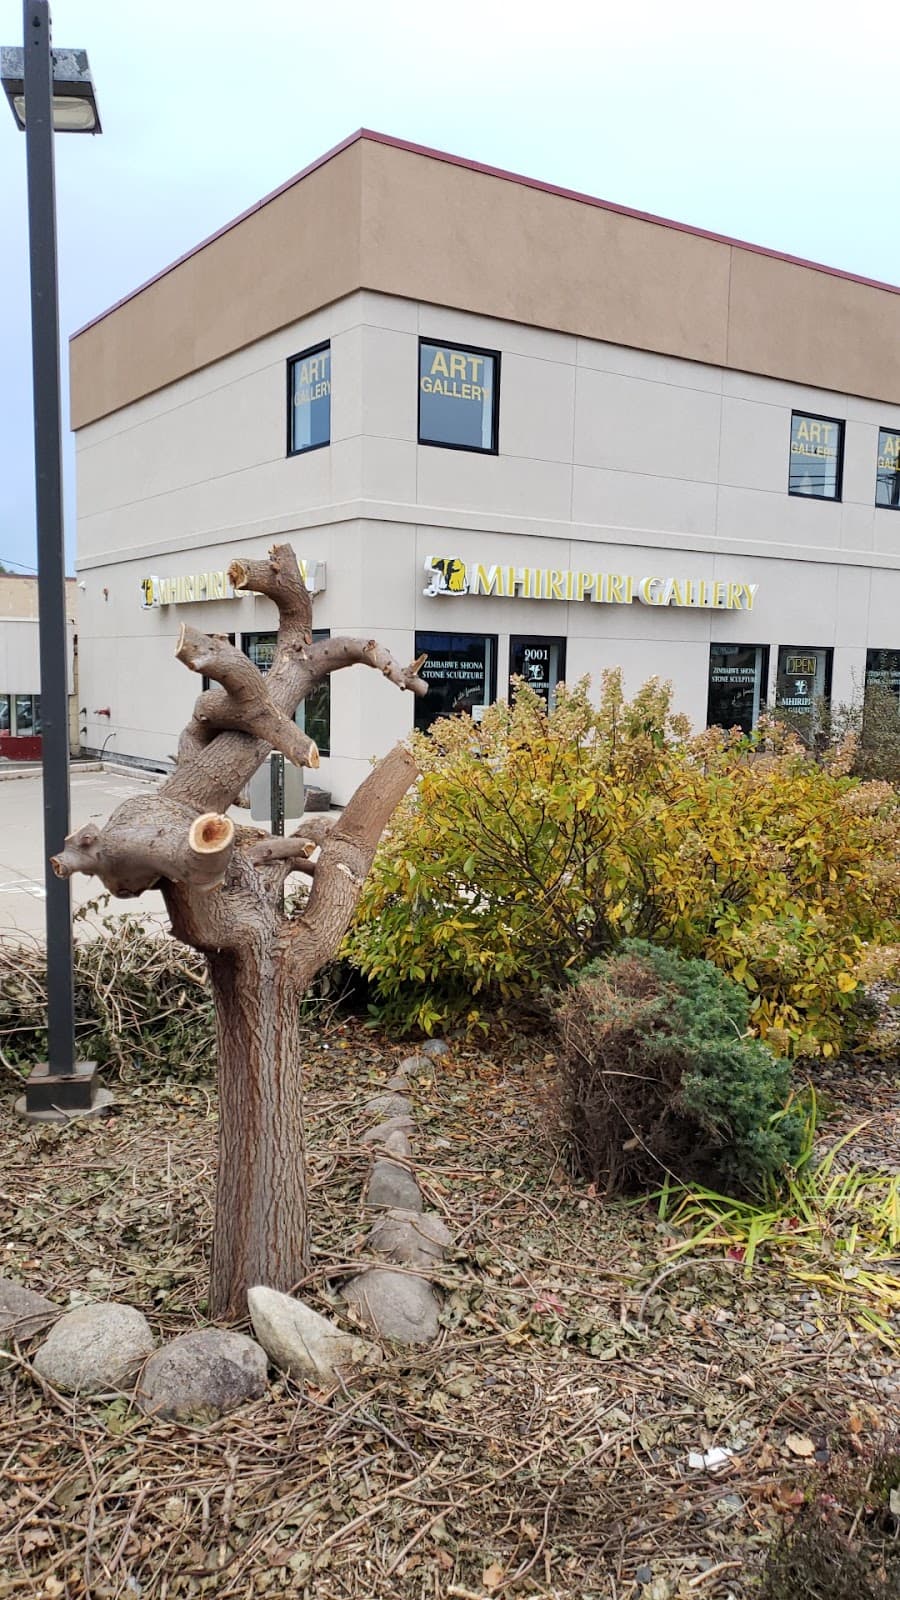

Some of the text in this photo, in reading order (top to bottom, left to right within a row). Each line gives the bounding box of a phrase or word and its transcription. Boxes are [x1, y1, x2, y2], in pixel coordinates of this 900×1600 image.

[301, 355, 327, 384] ART
[431, 351, 483, 382] ART
[421, 376, 489, 401] GALLERY
[797, 420, 832, 444] ART
[472, 563, 759, 611] MHIRIPIRI GALLERY
[424, 660, 483, 670] ZIMBABWE SHONA
[524, 648, 548, 661] 9001
[422, 670, 484, 680] STONE SCULPTURE
